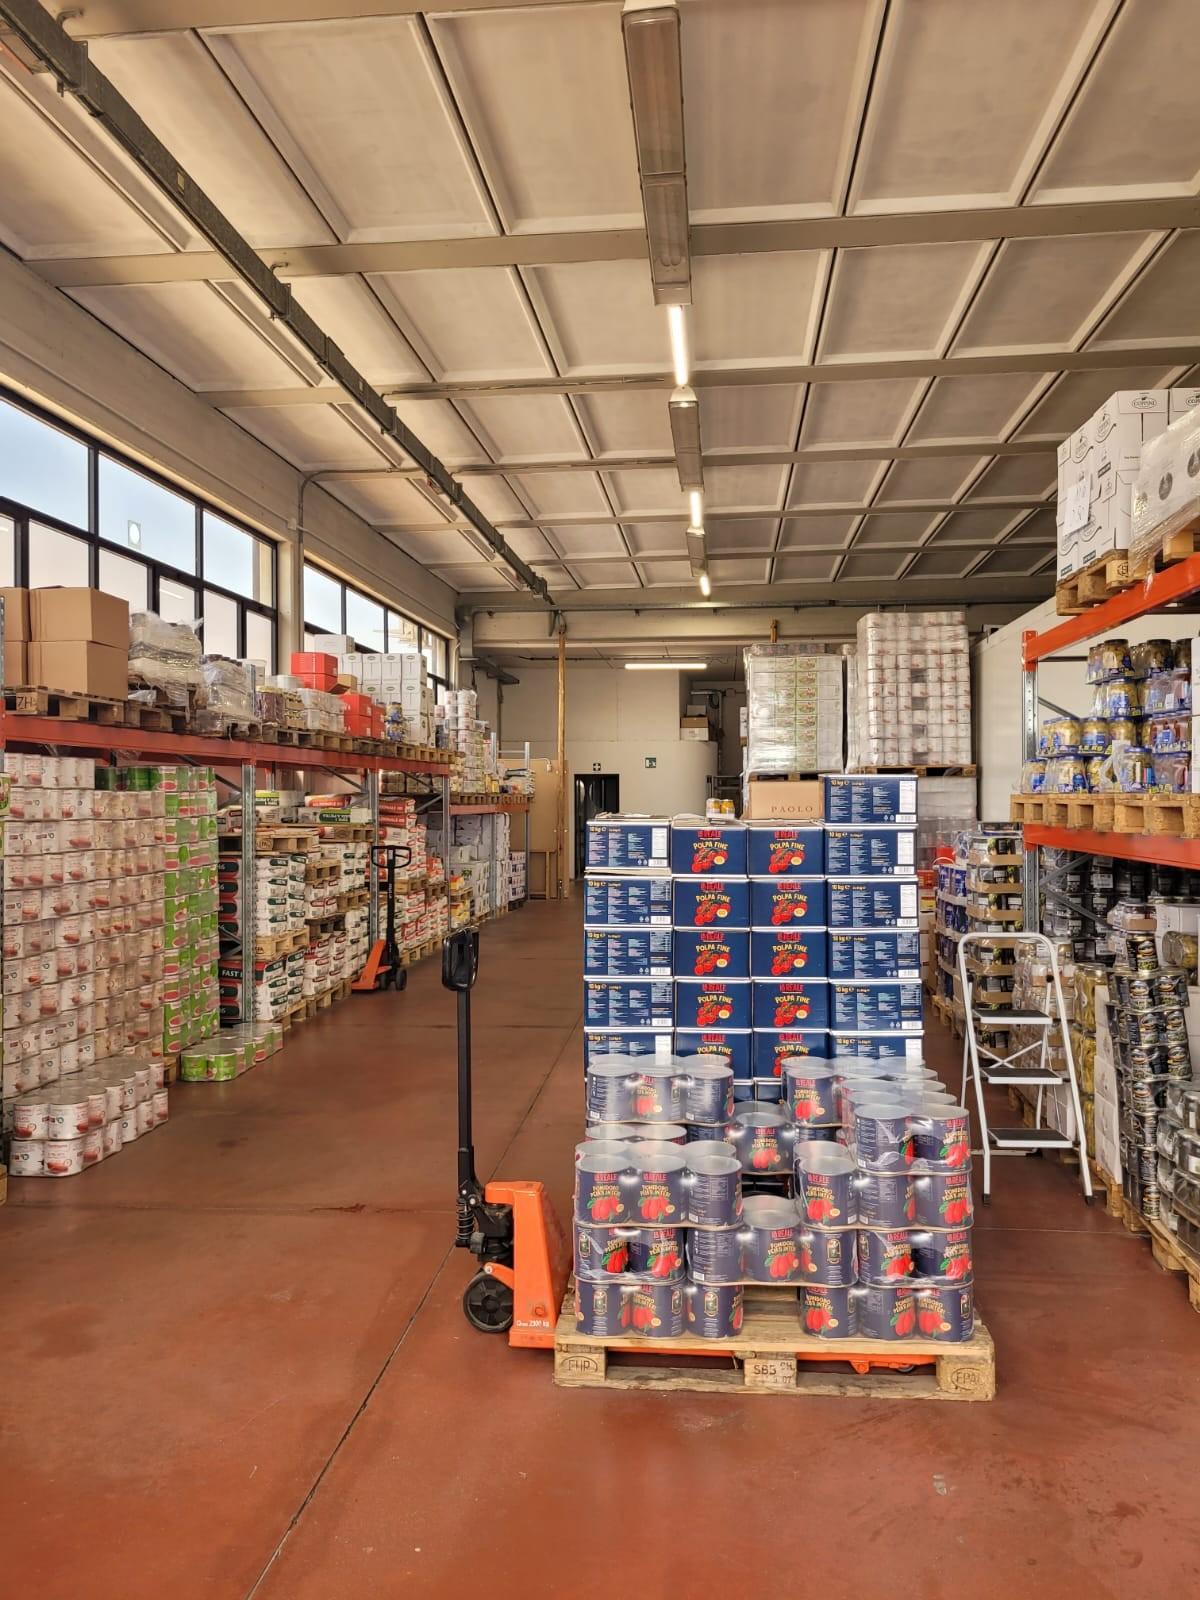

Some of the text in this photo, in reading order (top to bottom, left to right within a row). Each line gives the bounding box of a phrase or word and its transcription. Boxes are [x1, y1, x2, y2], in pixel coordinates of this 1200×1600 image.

[693, 842, 729, 850] POLPA FINE
[769, 842, 805, 850] POLPA FINE
[695, 894, 731, 903] POLPA FINE
[772, 894, 808, 902] POLPA FINE
[695, 944, 731, 952] POLPA FINE
[772, 944, 808, 952] POLPA FINE
[222, 969, 238, 977] FAST
[698, 995, 733, 1004] POLPA FINE
[775, 995, 811, 1004] POLPA FINE
[696, 1045, 733, 1055] POLPA FINE
[774, 1045, 809, 1054] POLPA FINE
